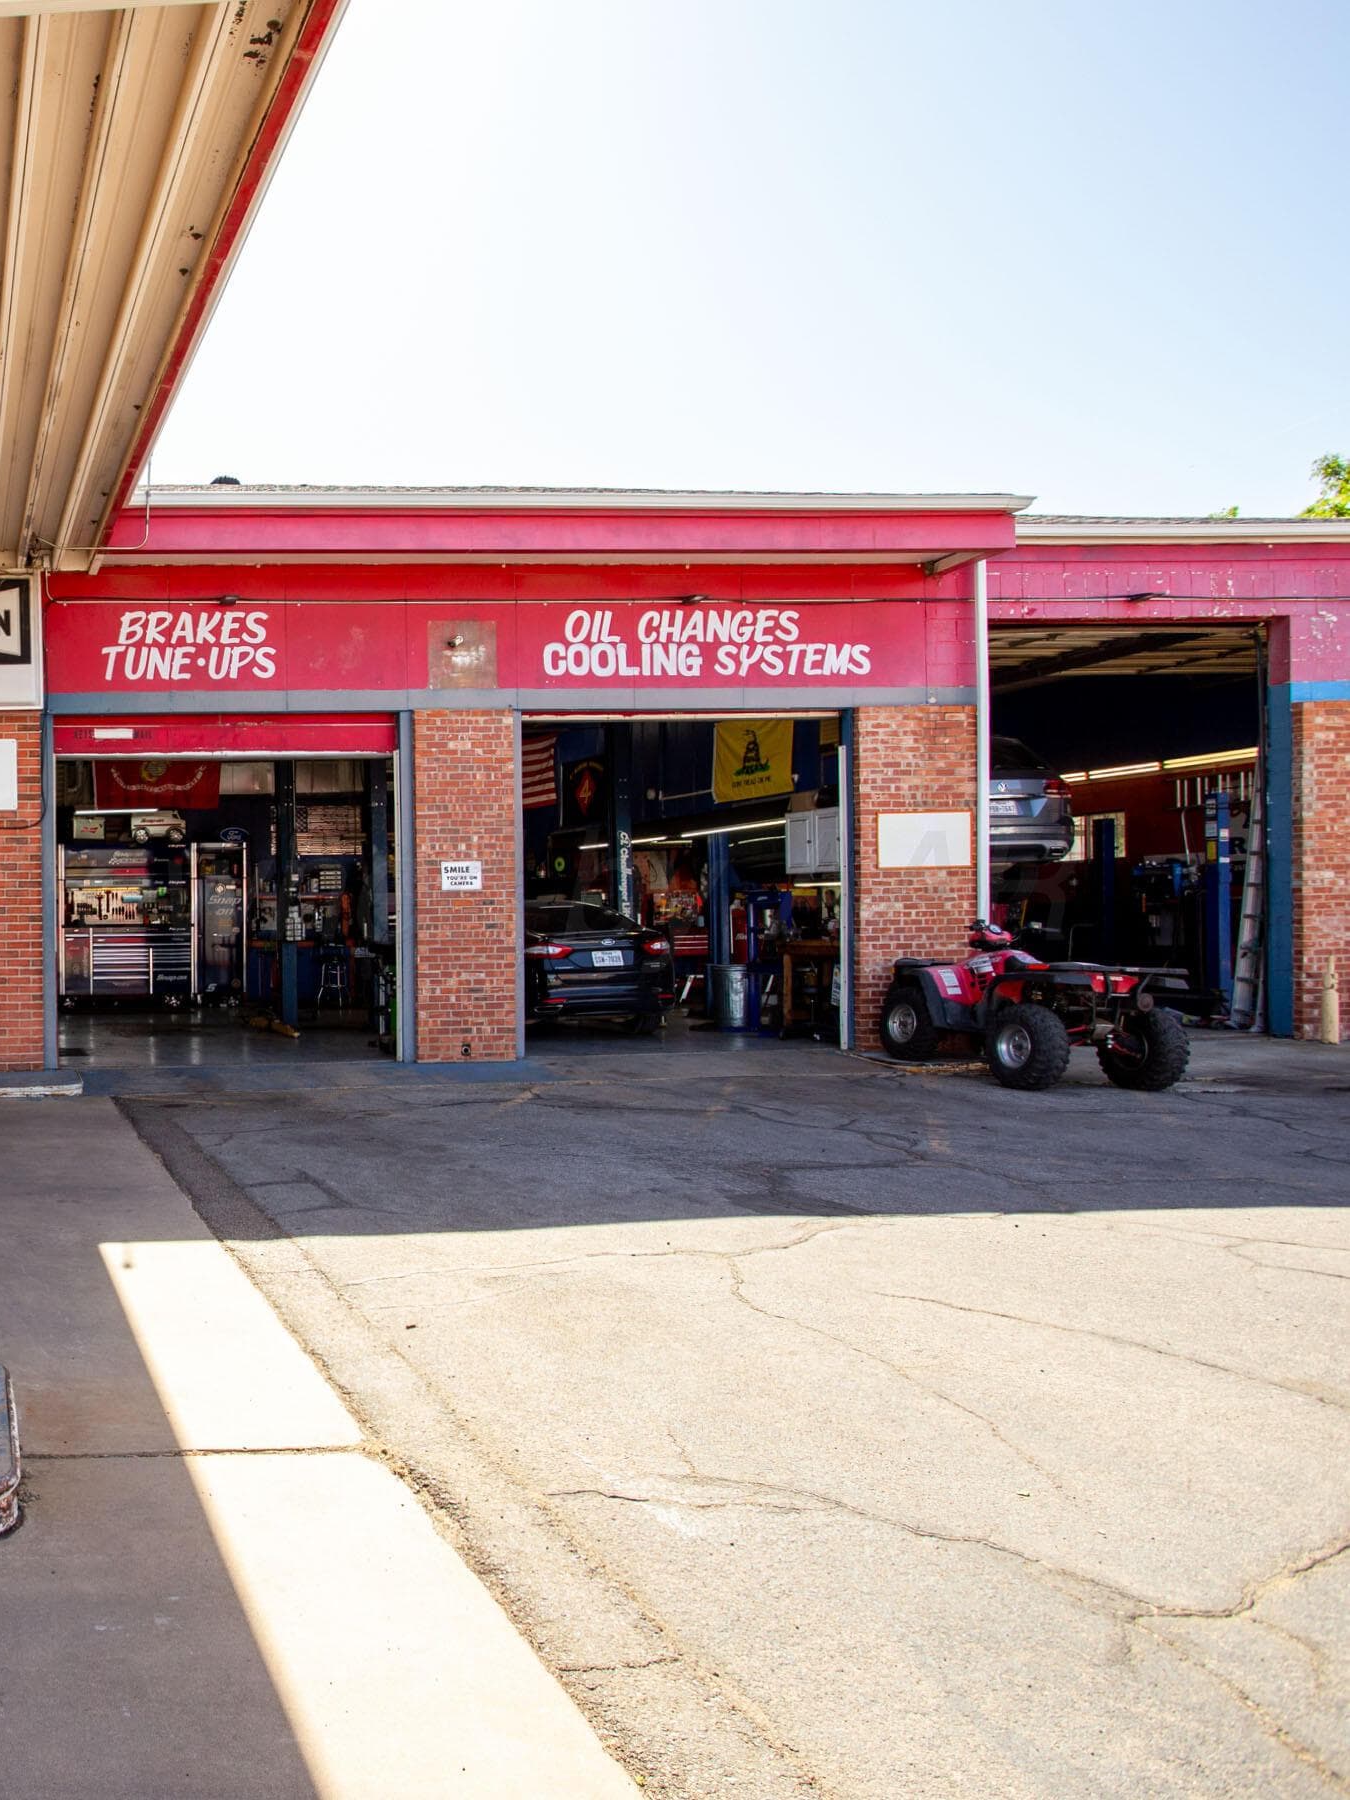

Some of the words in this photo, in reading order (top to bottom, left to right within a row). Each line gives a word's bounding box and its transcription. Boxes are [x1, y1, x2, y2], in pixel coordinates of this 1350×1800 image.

[118, 611, 269, 645] BRAKES
[564, 610, 621, 643] OIL
[637, 609, 800, 643] CHANGES
[542, 642, 703, 677] COOLING
[713, 643, 872, 677] SYSTEMS
